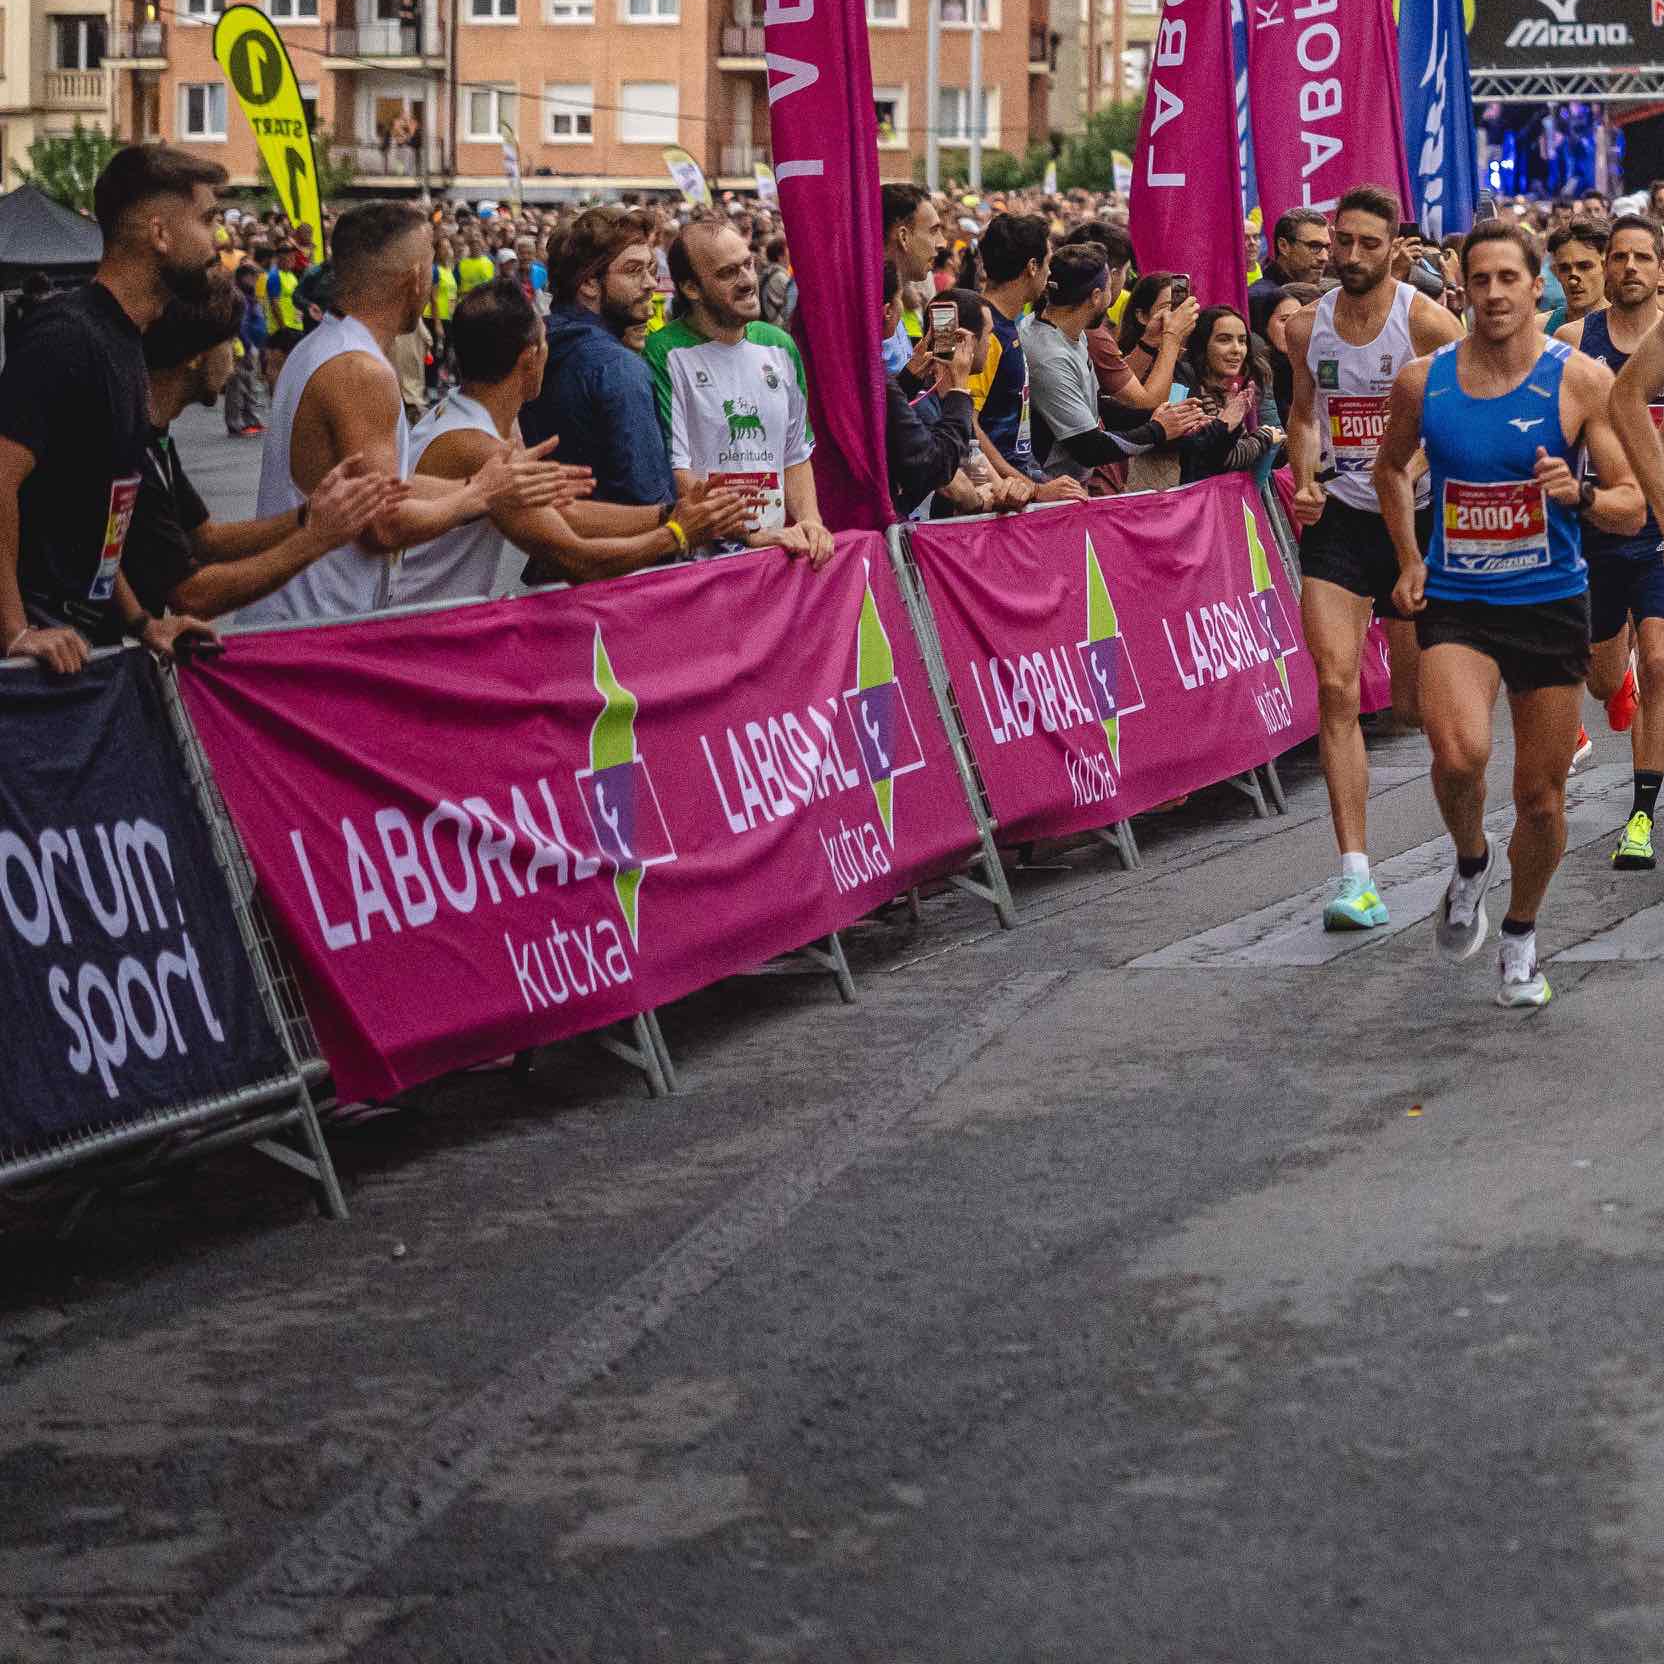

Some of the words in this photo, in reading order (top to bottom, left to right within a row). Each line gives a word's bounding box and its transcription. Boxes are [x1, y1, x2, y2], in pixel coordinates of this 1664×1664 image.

[719, 448, 775, 465] plenitude
[1456, 504, 1531, 531] 20004
[1162, 595, 1270, 690] LABORAL
[970, 645, 1094, 745] LABORAL
[1252, 685, 1293, 739] kutxa
[700, 696, 859, 834] LABORAL
[1065, 746, 1118, 807] kutxa
[291, 779, 600, 952] LABORAL
[818, 817, 891, 895] kutxa
[503, 916, 635, 1014] kutxa
[49, 931, 225, 1098] sport
